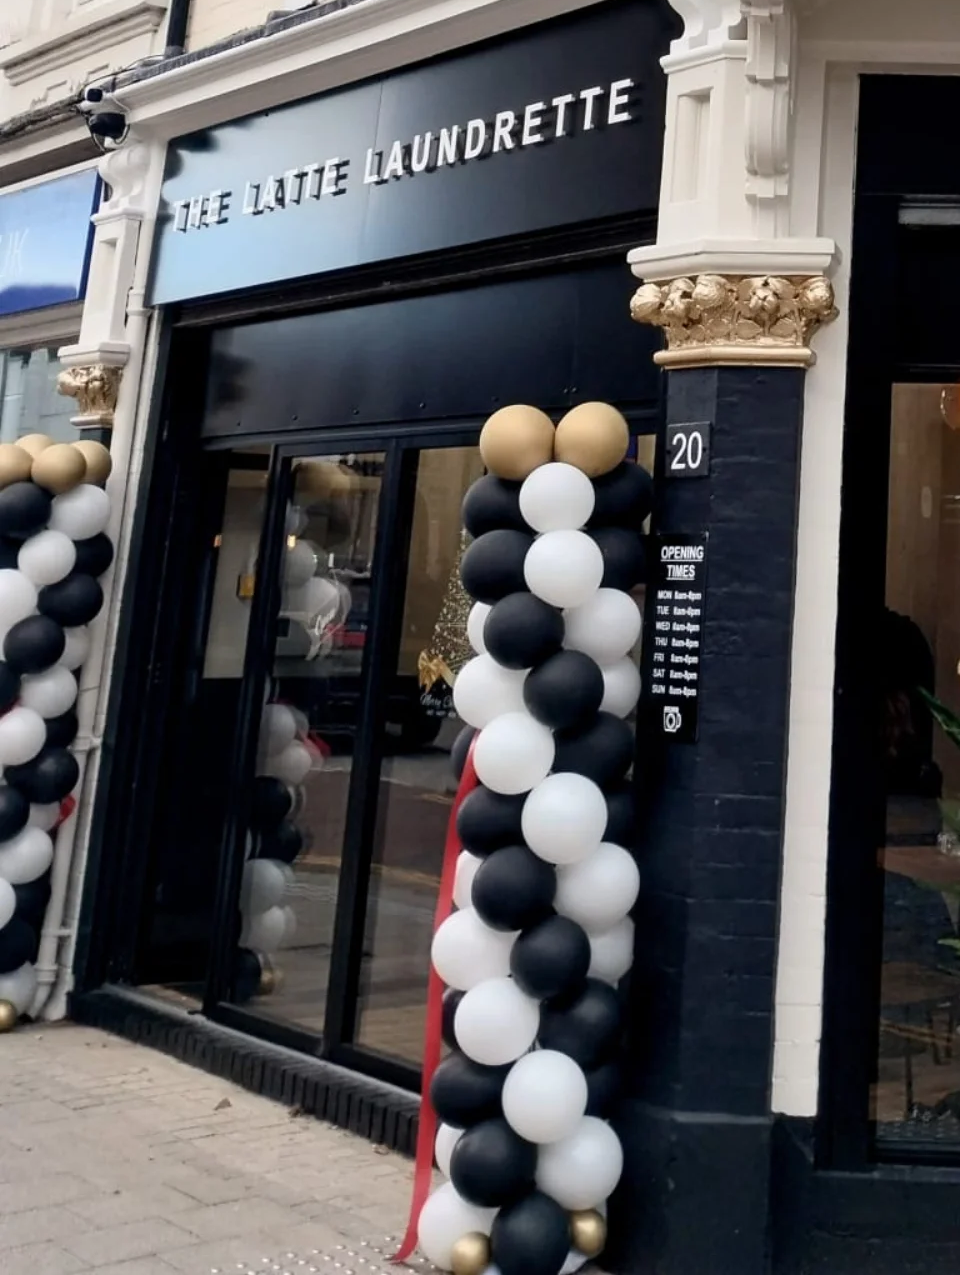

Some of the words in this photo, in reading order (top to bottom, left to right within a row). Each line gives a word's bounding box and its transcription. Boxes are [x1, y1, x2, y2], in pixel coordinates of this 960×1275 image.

[173, 189, 223, 232] THE
[242, 157, 340, 215] LATTE
[363, 78, 634, 185] LAUNDRETTE
[670, 431, 702, 470] 20
[661, 545, 704, 561] OPENING
[666, 564, 696, 579] TIMES
[657, 590, 672, 600] MON
[656, 605, 670, 615] TUE
[655, 621, 671, 631] WED
[655, 637, 668, 646] THU
[653, 652, 665, 662] FRI
[652, 668, 666, 678] SAT
[651, 684, 666, 694] SUN
